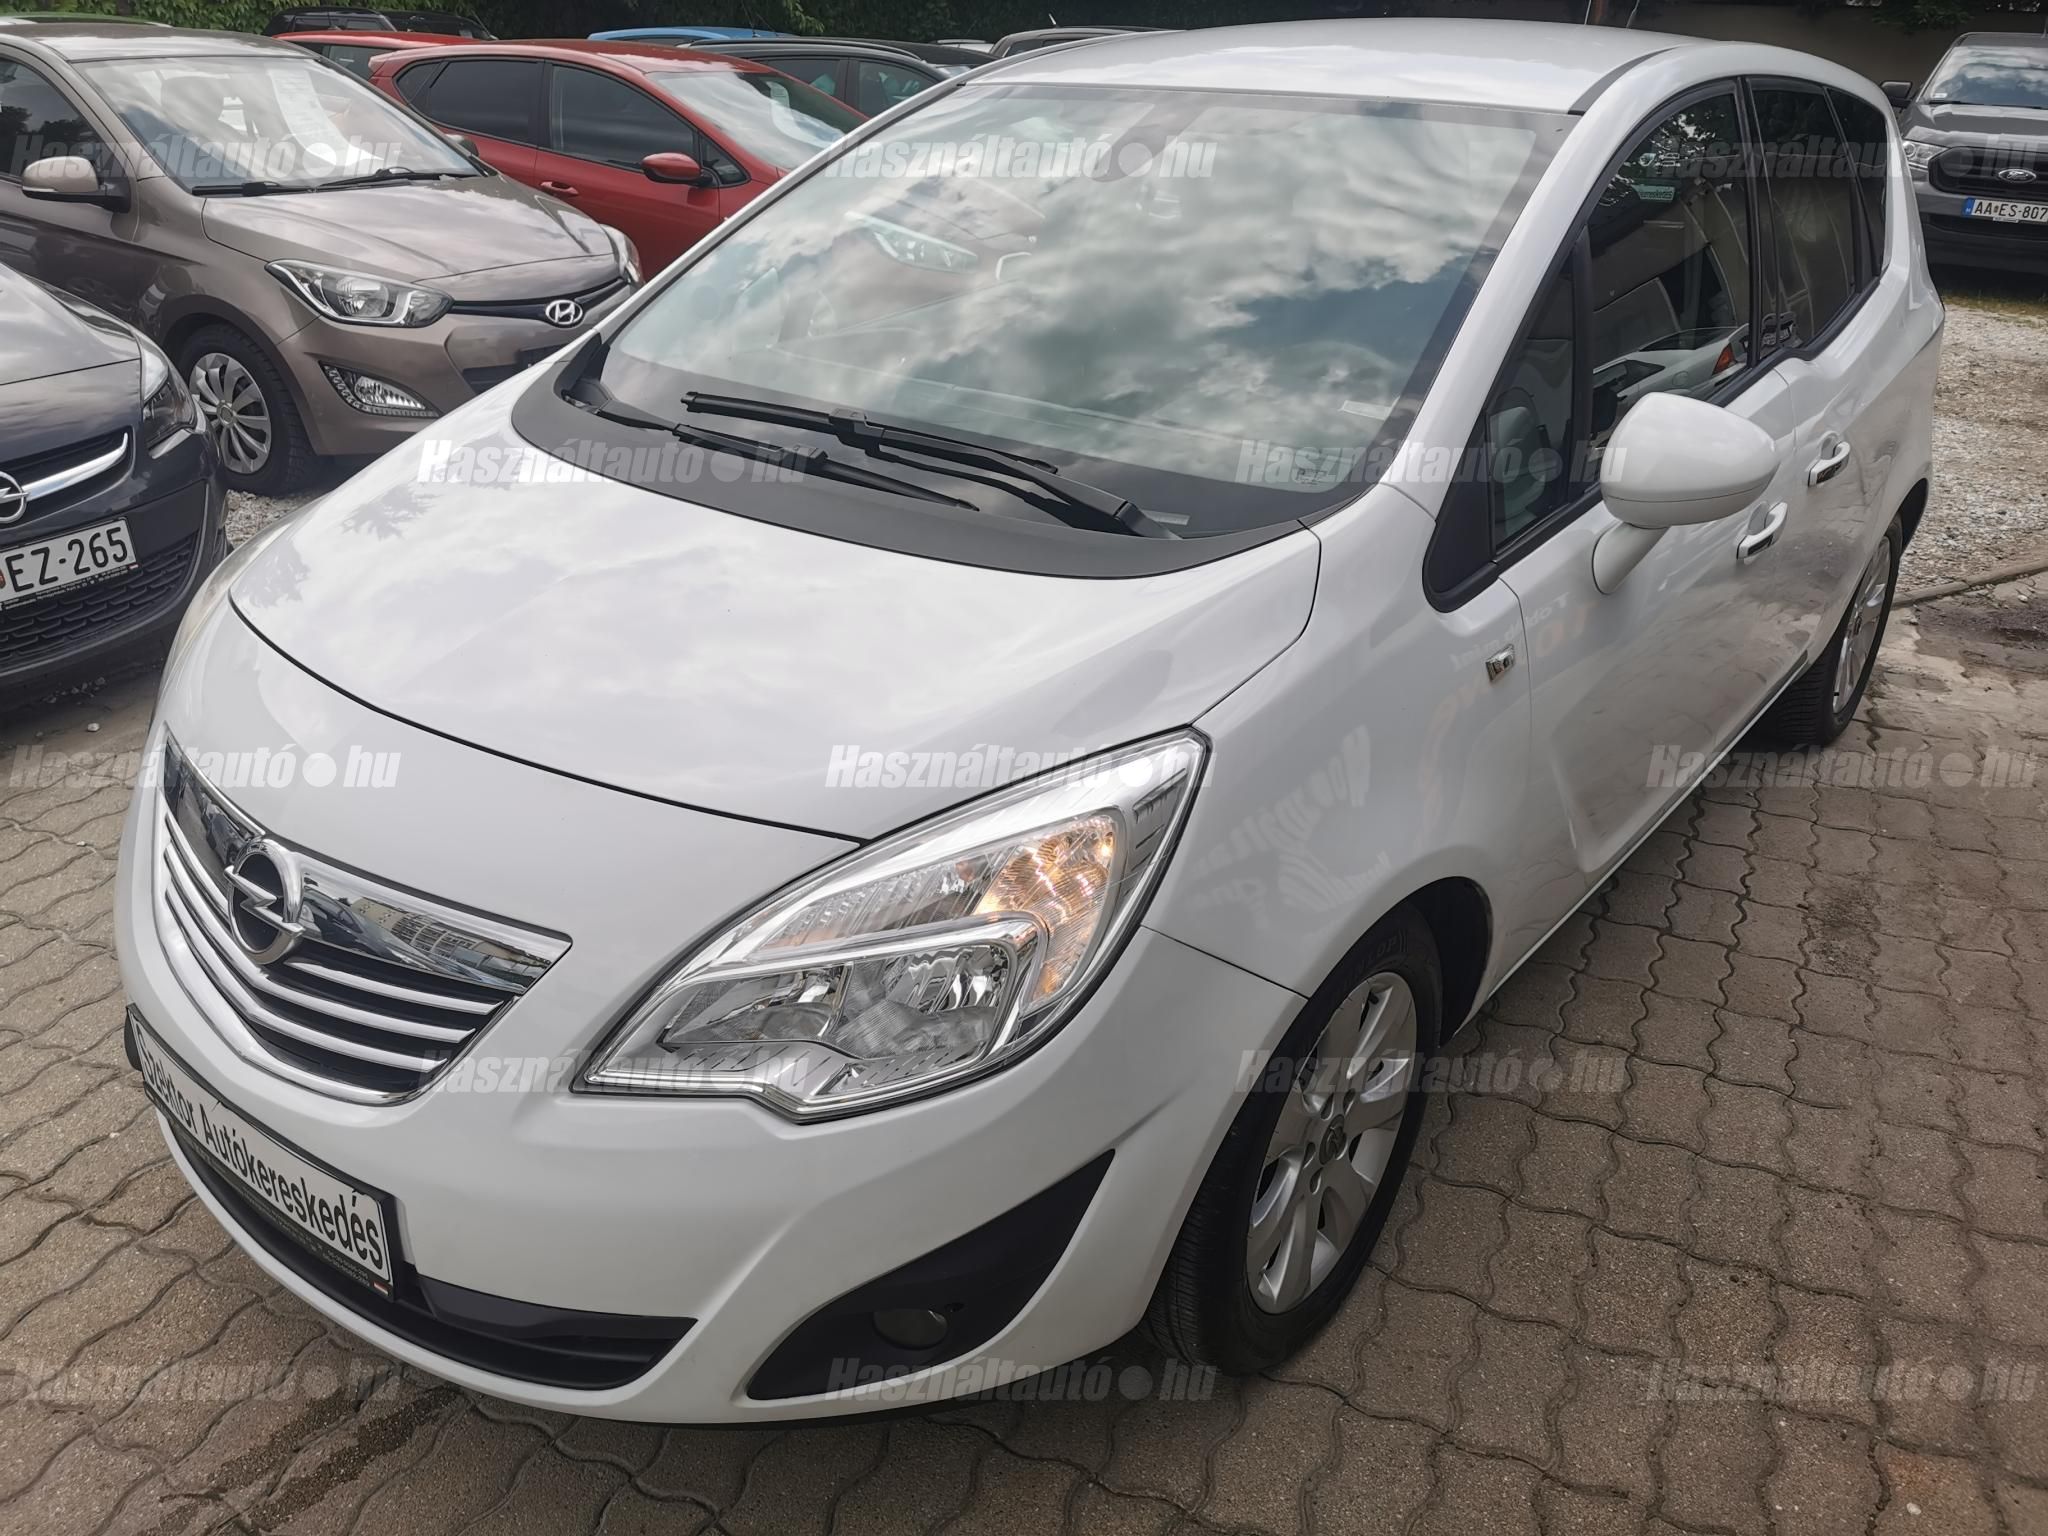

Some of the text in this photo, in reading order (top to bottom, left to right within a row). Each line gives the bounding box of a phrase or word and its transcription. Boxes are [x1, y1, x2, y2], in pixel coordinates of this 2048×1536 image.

[1974, 201, 1993, 216] AA
[1998, 203, 2048, 220] ES-807
[5, 526, 128, 593] EZ-265
[199, 1102, 383, 1271] Autókereskedés
